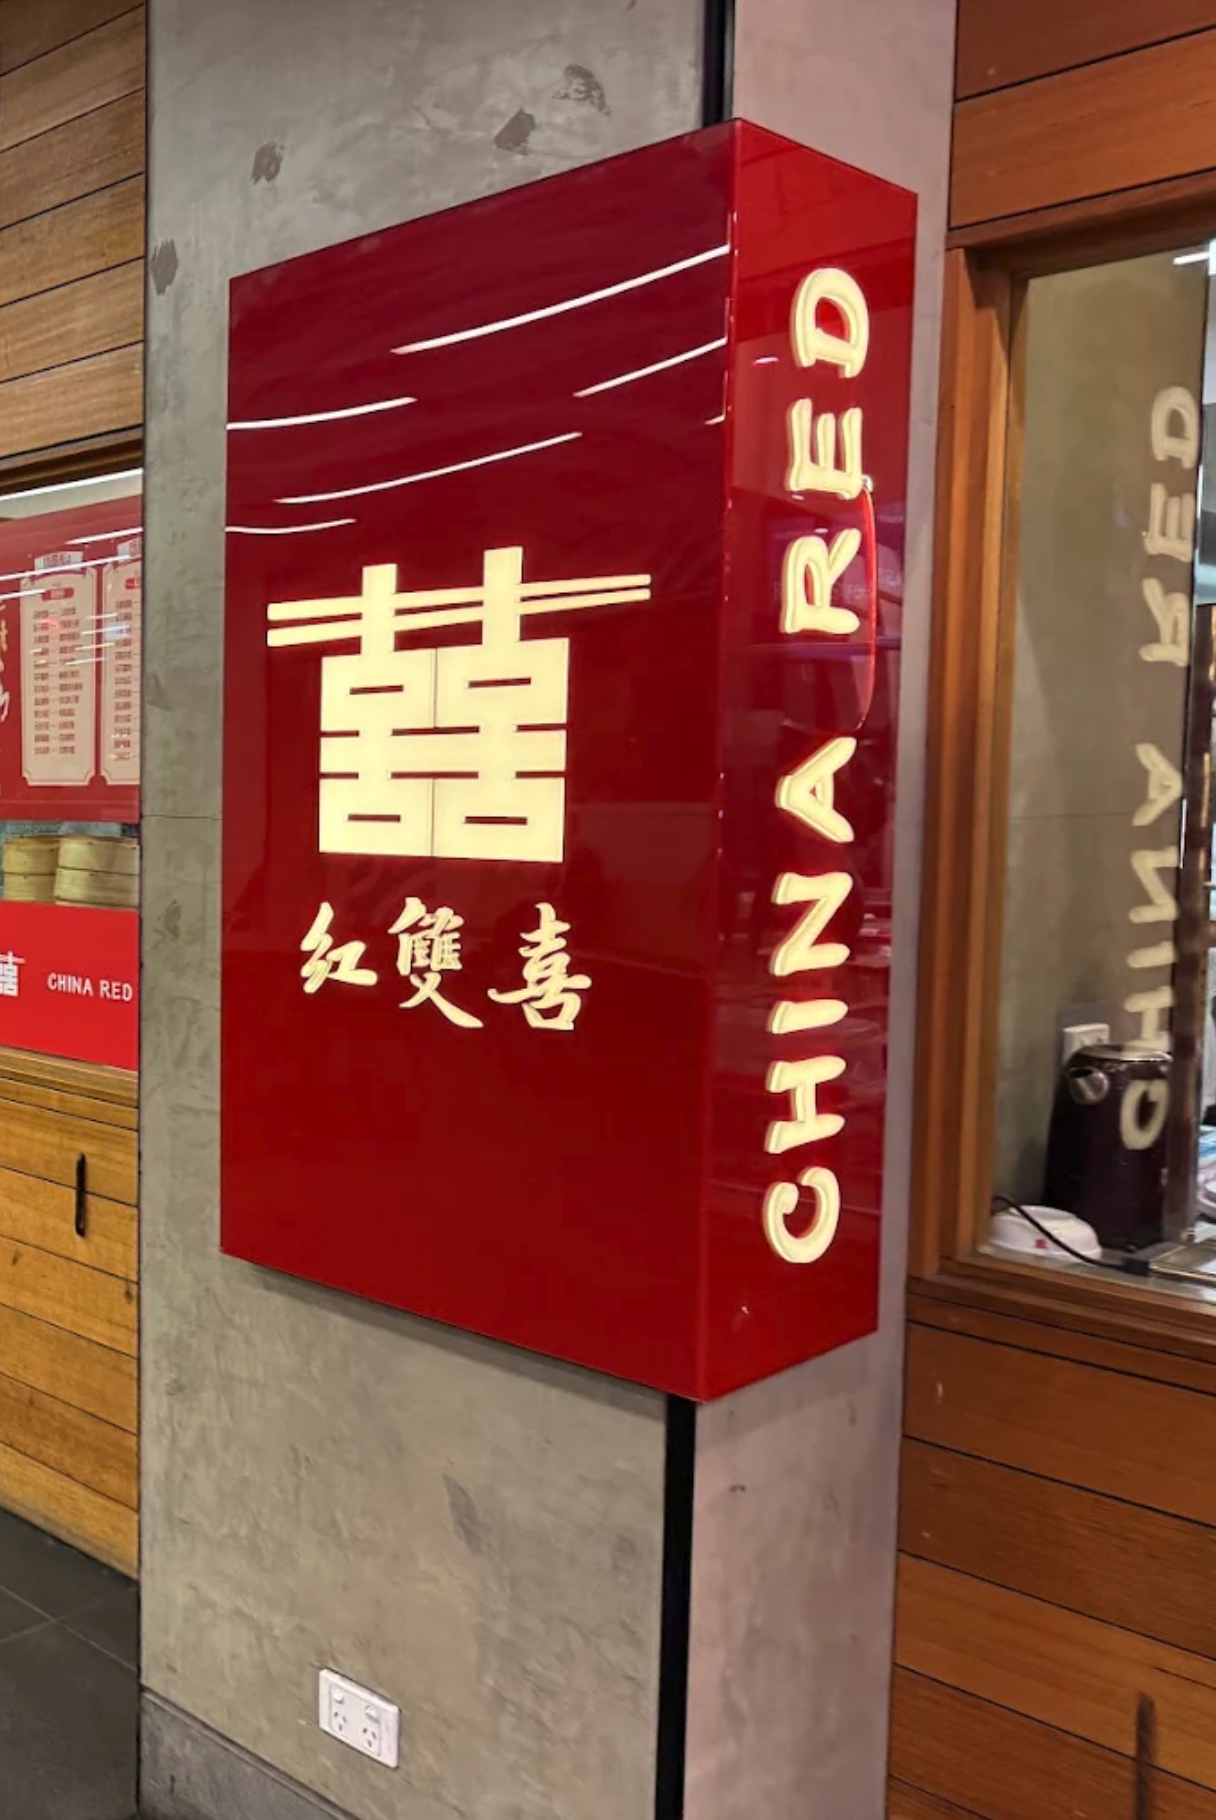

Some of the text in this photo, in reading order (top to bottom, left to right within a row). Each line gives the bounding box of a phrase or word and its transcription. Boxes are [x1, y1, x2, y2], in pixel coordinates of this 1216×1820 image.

[780, 267, 870, 636] RED
[47, 972, 134, 1002] CHINA RED
[299, 896, 593, 1032] 红雙喜
[763, 736, 857, 1263] CHINA
